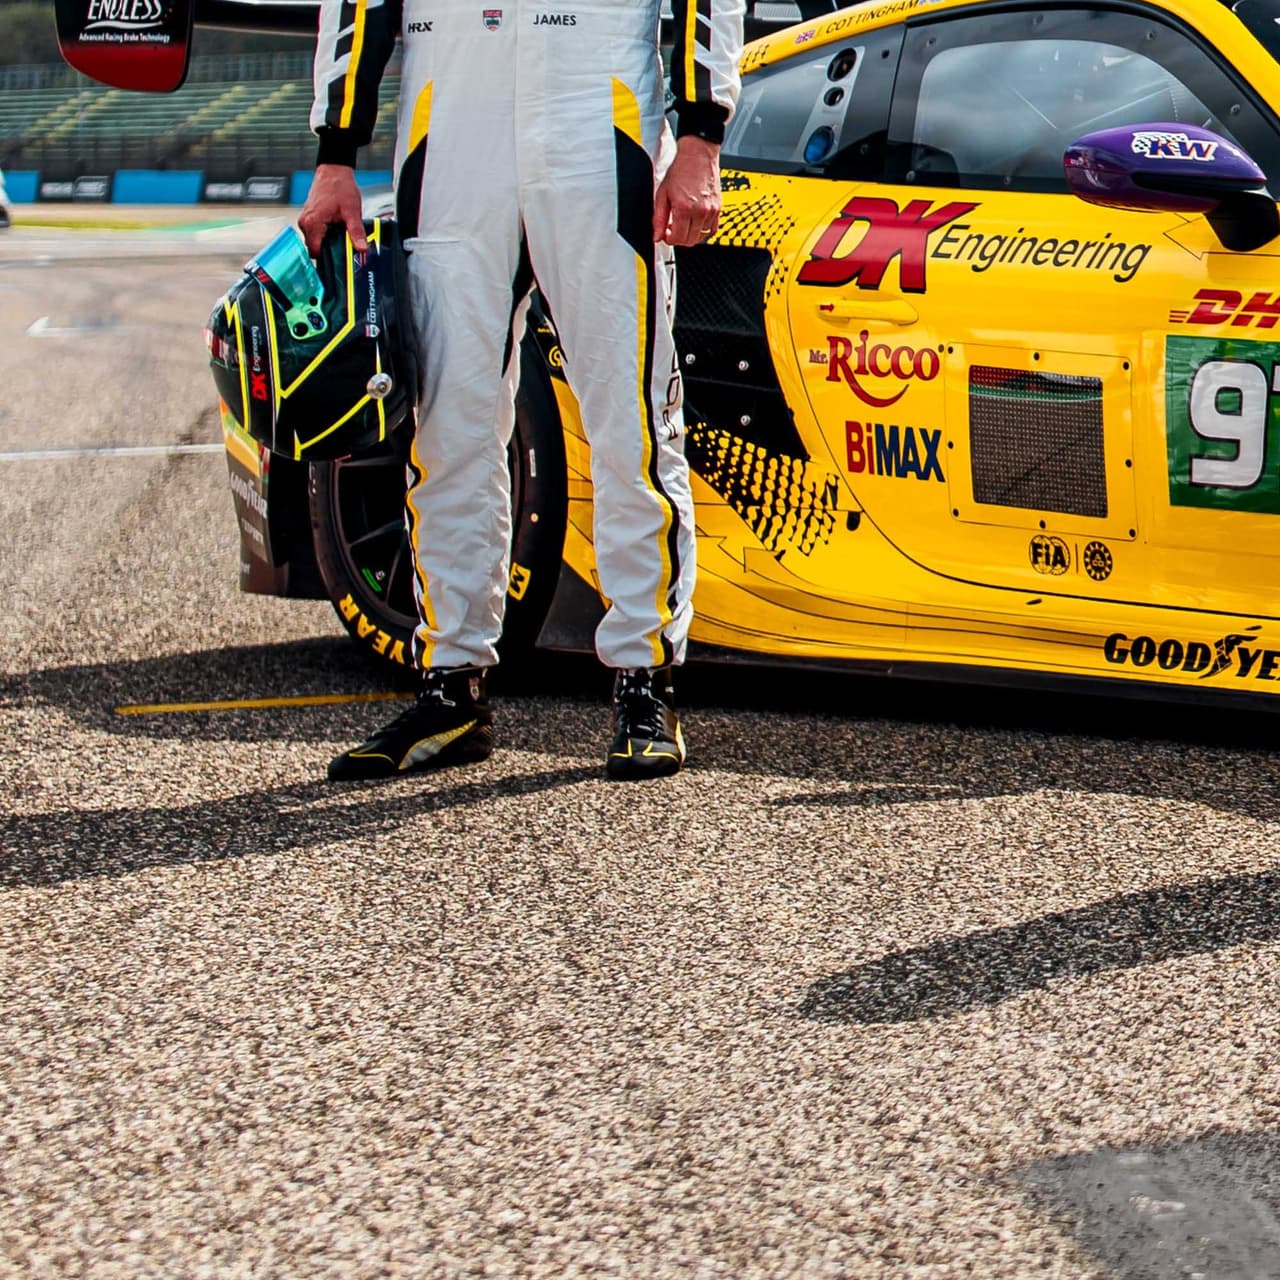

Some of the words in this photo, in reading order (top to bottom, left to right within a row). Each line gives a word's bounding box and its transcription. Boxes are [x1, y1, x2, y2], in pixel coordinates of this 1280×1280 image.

[407, 21, 433, 33] HRX
[533, 14, 577, 26] JAMES
[1147, 137, 1214, 160] KW
[796, 195, 984, 295] DK
[930, 223, 1153, 283] Engineering
[368, 271, 377, 324] COTTINGHAM
[251, 325, 260, 372] Engineering
[809, 349, 829, 365] Mr.
[251, 372, 268, 401] DK
[845, 420, 945, 483] BiMAX
[1031, 542, 1068, 570] FIA
